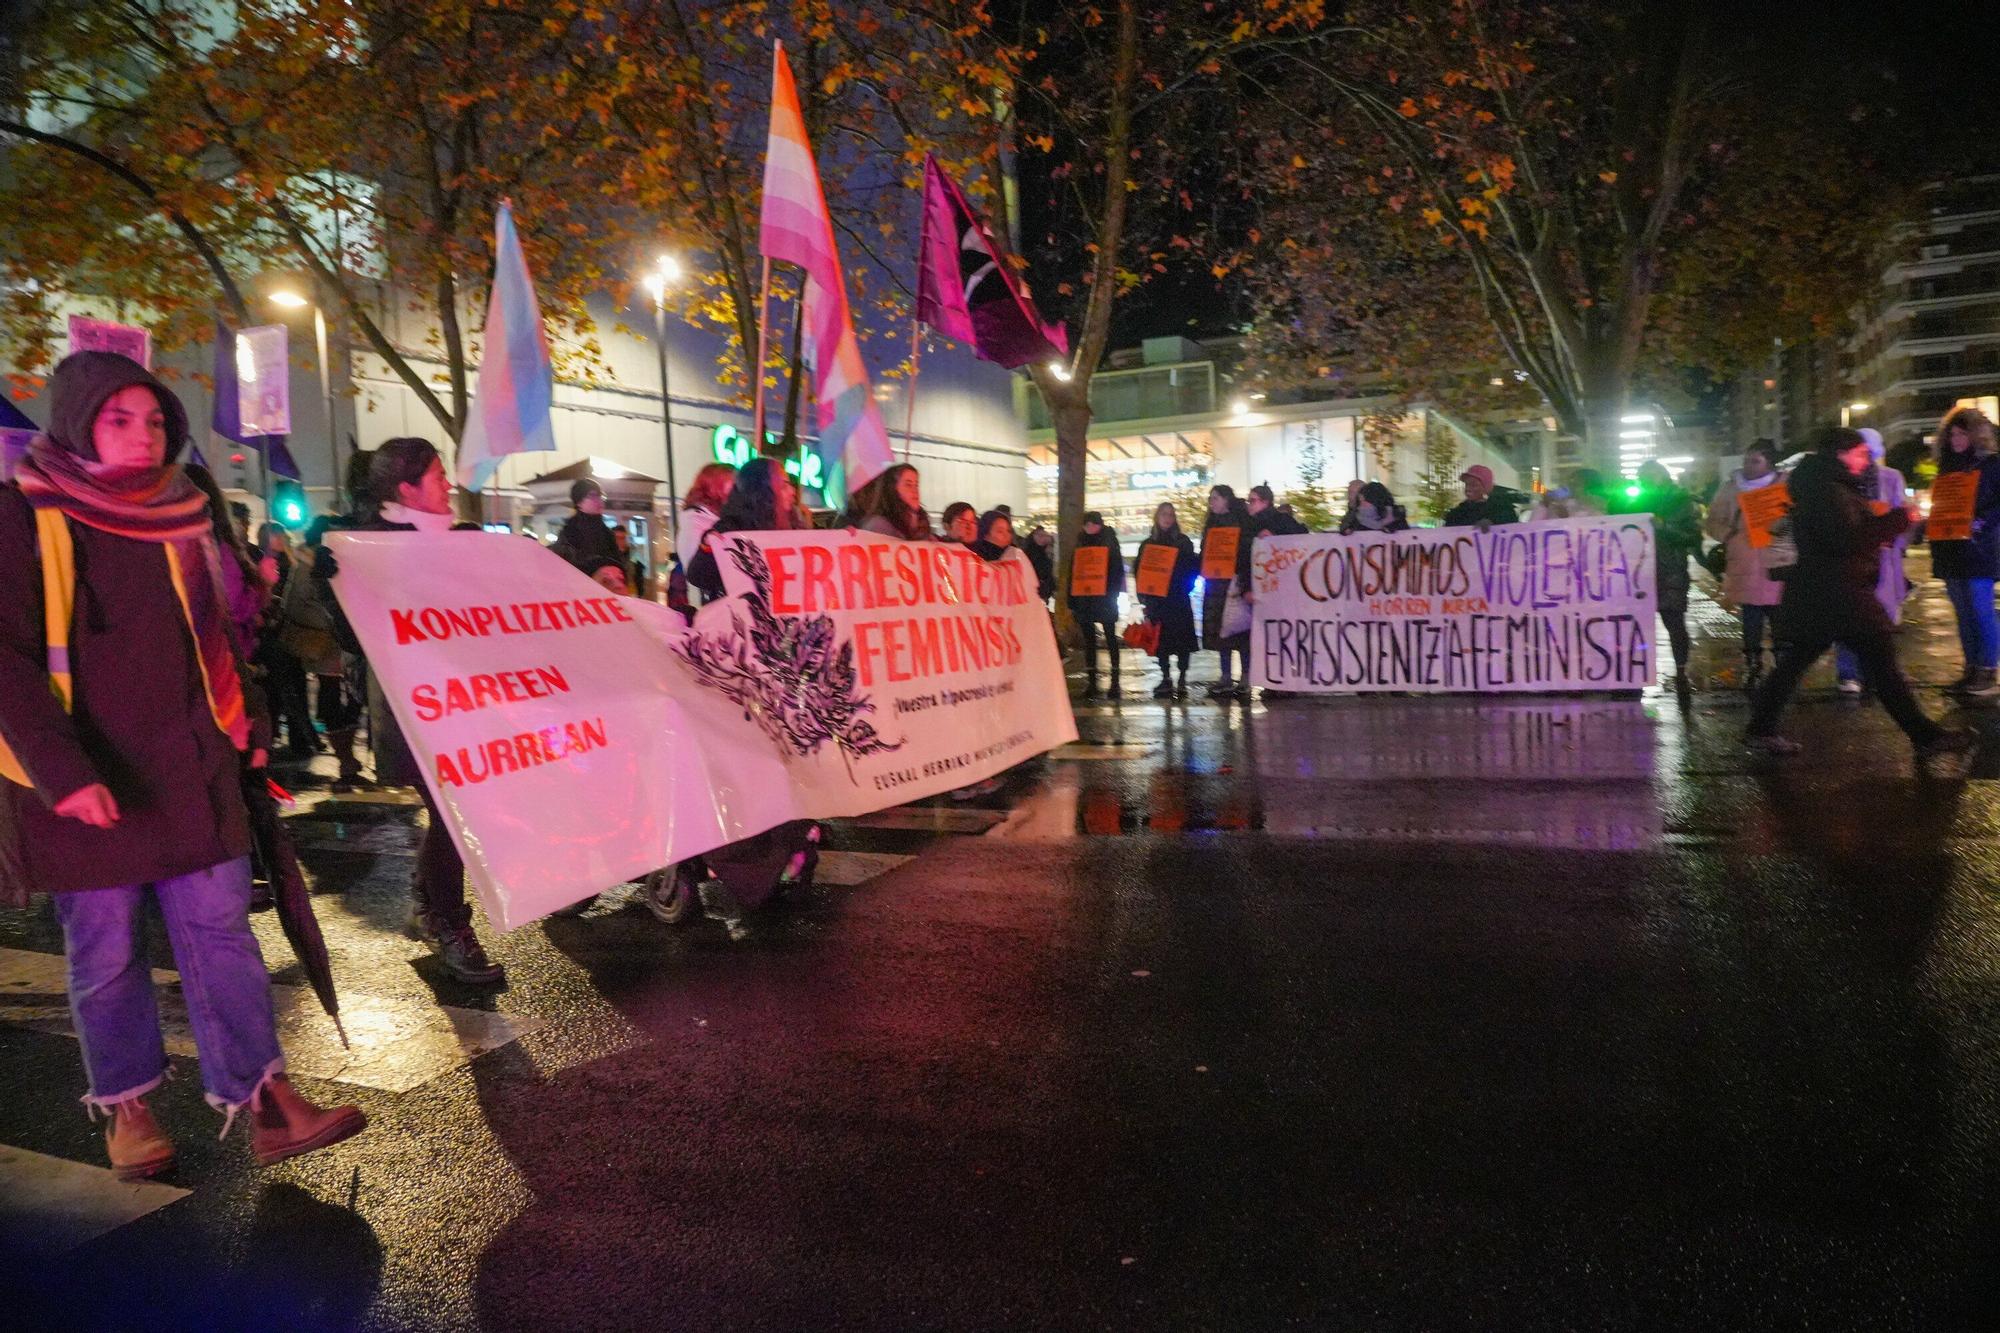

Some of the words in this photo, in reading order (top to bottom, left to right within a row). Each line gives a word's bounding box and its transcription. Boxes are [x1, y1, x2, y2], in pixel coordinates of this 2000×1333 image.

[1300, 534, 1473, 602] CONSUMIMOS
[1473, 523, 1648, 609] VIOLENCIA?
[389, 598, 633, 645] KONPLIZITATE
[1471, 612, 1648, 689] FEMINISTA
[411, 665, 570, 722] SAREEN
[435, 717, 608, 788] AURREAN
[873, 768, 919, 791] EUSKAL
